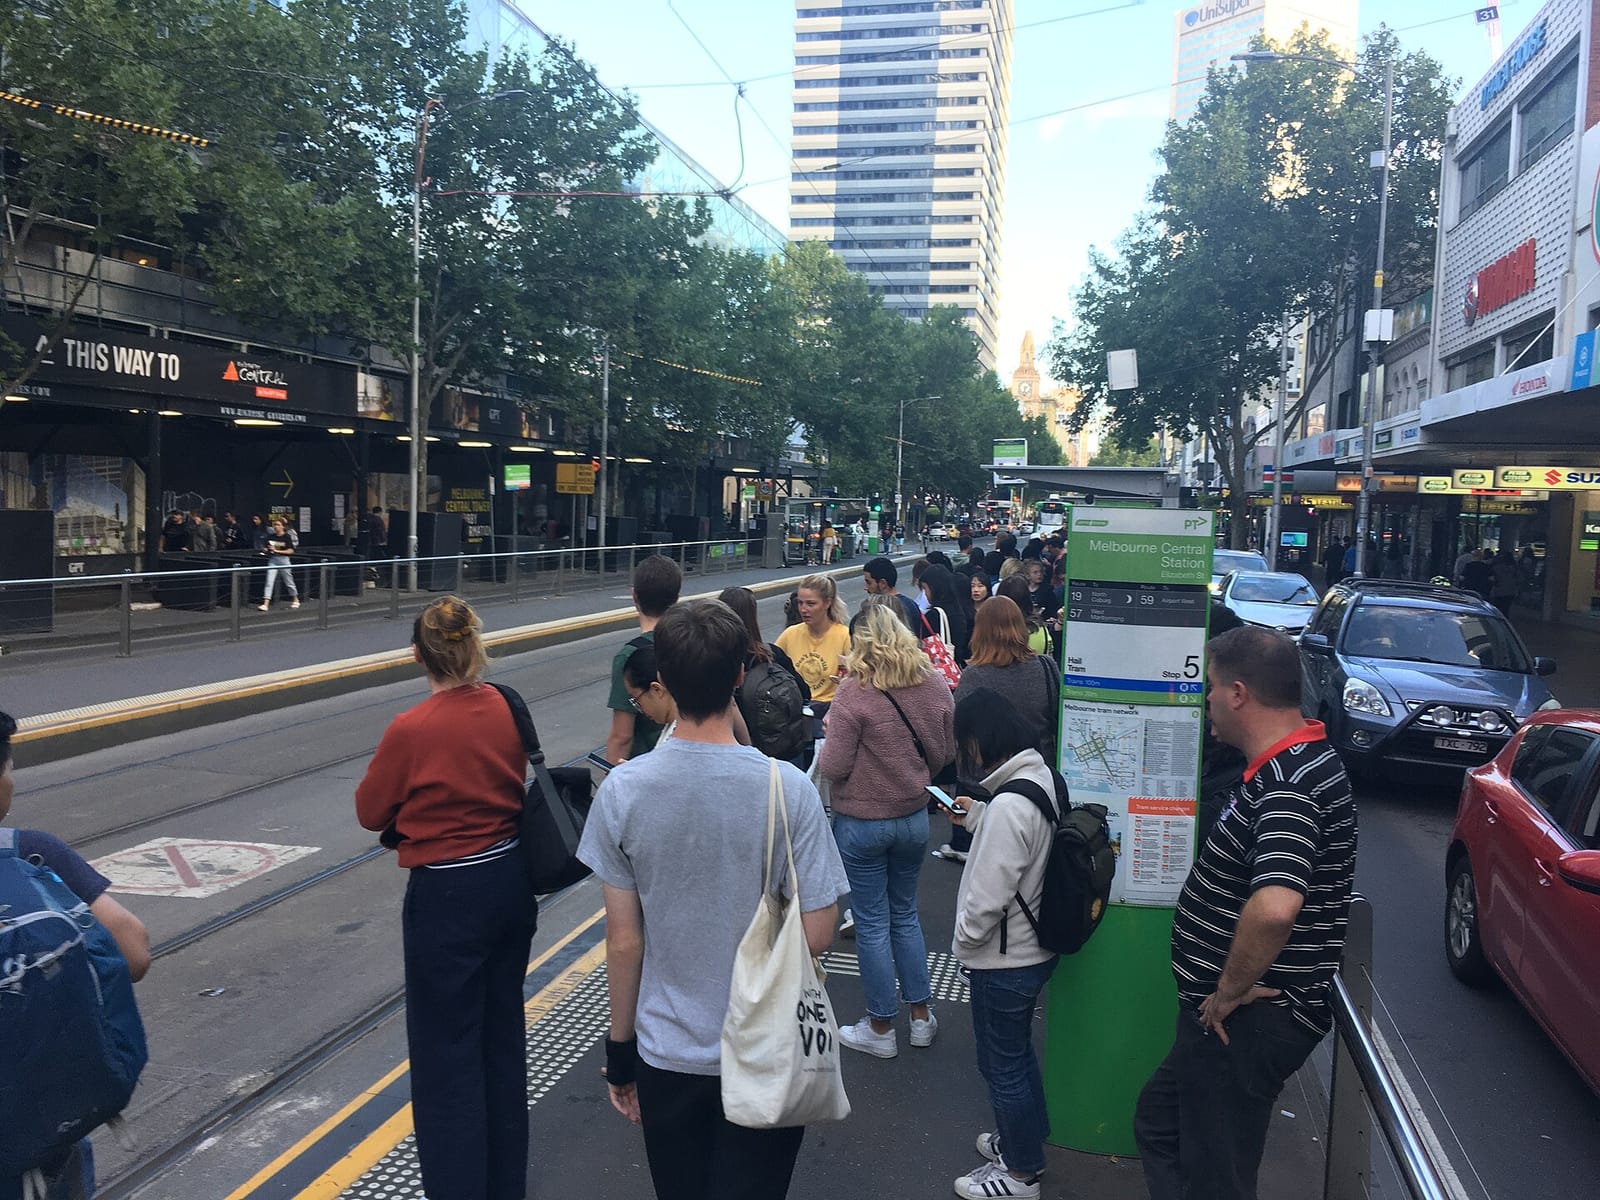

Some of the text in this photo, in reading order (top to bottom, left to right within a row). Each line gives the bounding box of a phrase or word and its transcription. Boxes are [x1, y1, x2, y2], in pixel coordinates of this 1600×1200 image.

[1480, 9, 1495, 21] 31
[63, 338, 180, 381] THIS WAY TO
[1519, 376, 1548, 394] HONDA
[1089, 540, 1206, 555] Melbourne Central
[1161, 557, 1205, 568] Station
[1071, 592, 1082, 601] 19
[1140, 595, 1154, 605] 59
[1069, 608, 1083, 618] 57
[1068, 665, 1086, 673] Tram
[1184, 655, 1199, 679] 5
[1162, 671, 1181, 680] Stop
[1065, 703, 1096, 712] Melbourne
[797, 1000, 827, 1024] ONE
